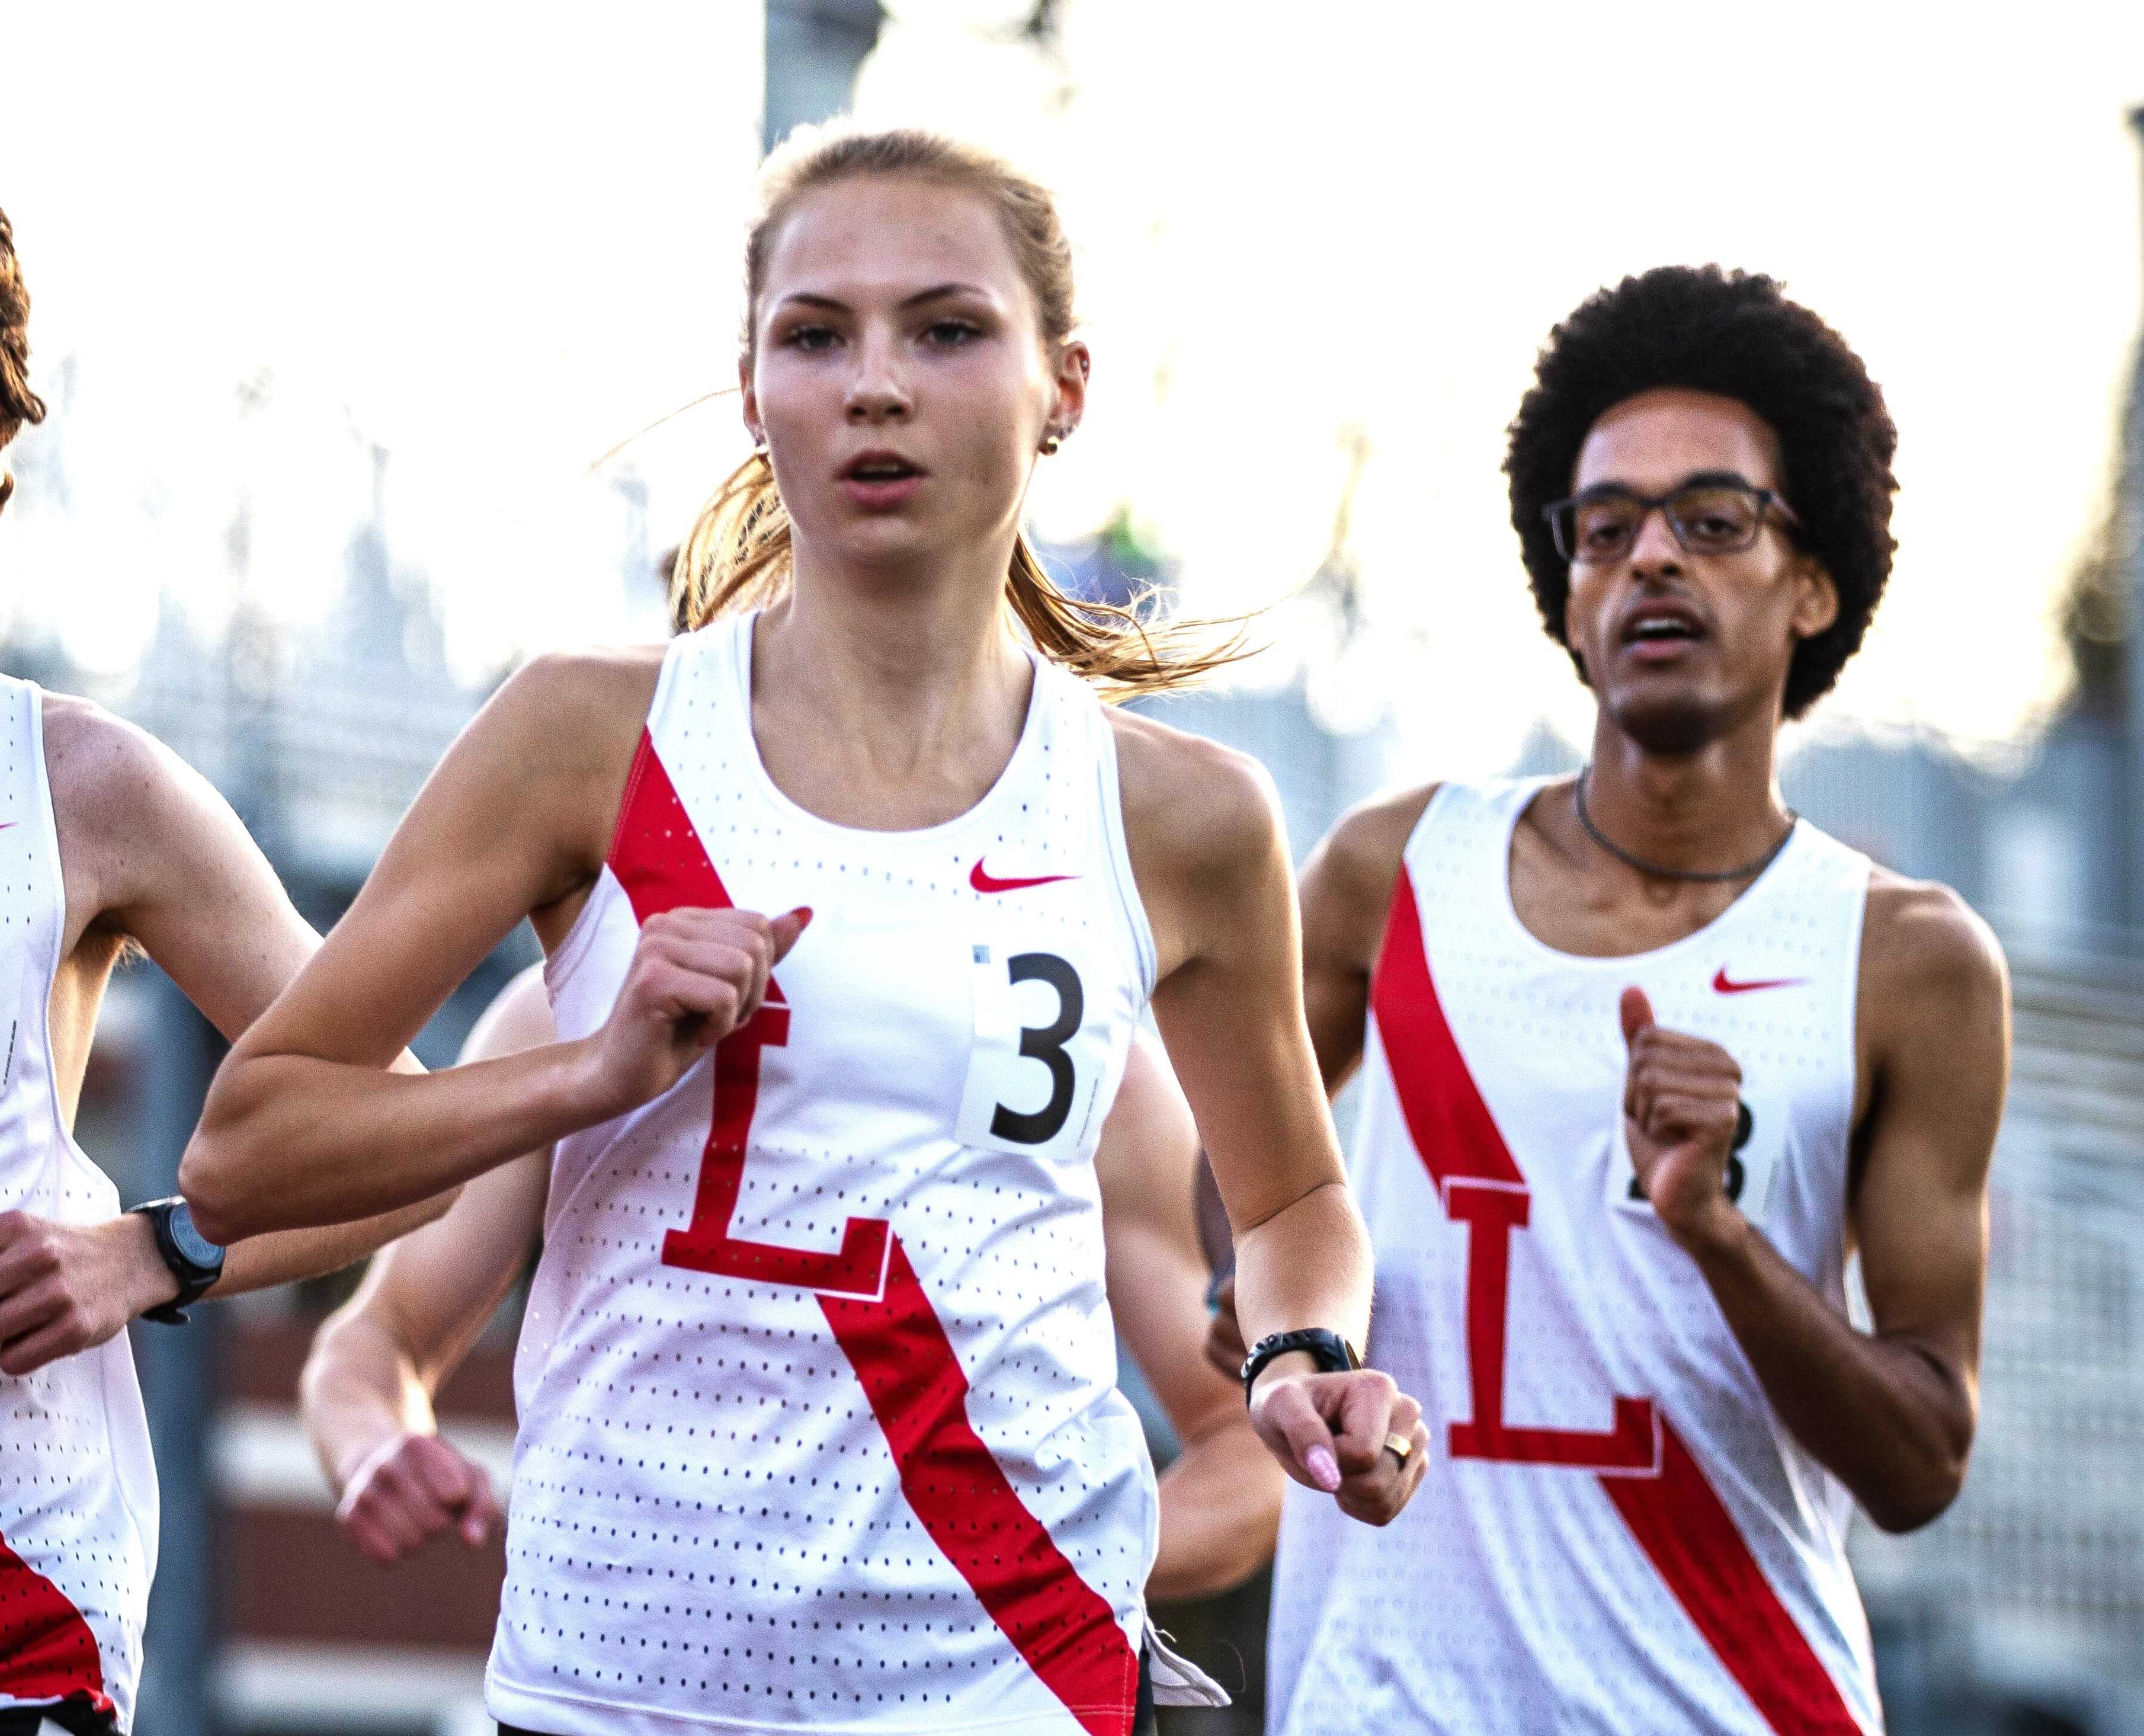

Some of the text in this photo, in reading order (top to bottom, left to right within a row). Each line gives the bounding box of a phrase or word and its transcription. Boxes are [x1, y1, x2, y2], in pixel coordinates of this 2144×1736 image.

[661, 1005, 891, 1302] L
[990, 952, 1084, 1145] 3
[1446, 1182, 1660, 1474] L
